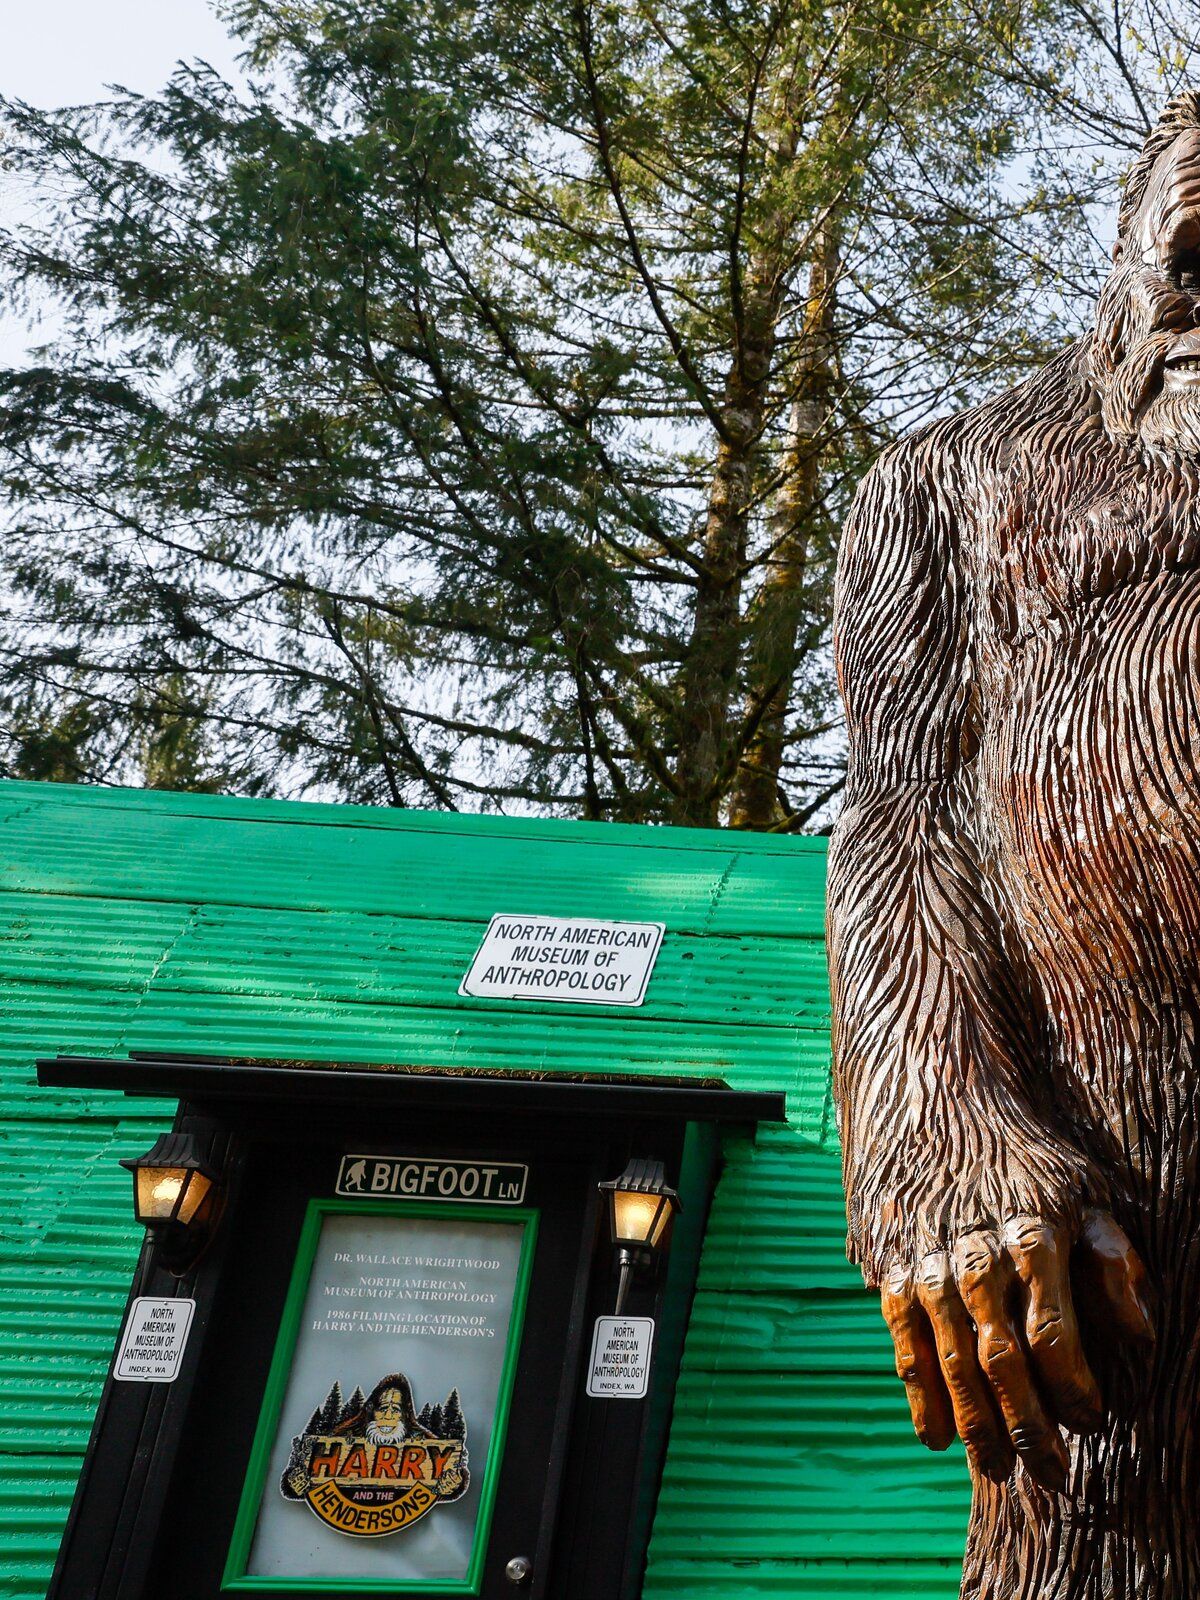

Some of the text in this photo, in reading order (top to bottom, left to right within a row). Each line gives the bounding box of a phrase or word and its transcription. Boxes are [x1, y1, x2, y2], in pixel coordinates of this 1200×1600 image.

[495, 924, 651, 948] NORTH AMERICAN
[511, 946, 618, 967] MUSEUM OF
[481, 966, 632, 991] ANTHROPOLOGY
[371, 1163, 519, 1198] BIGFOOT LN
[334, 1253, 500, 1270] DR. WALLACE WRIGHTWOOD
[359, 1277, 467, 1290] NORTH AMERICAN
[324, 1287, 497, 1303] MUSEUM OF ANTHROPOLOGY
[150, 1308, 174, 1319] NORTH
[327, 1310, 487, 1326] 1986 FILMING LOCATION OF
[141, 1322, 176, 1333] AMERICAN
[312, 1321, 356, 1332] HARRY
[357, 1323, 383, 1333] AND
[385, 1324, 410, 1334] THE
[613, 1327, 635, 1338] NORTH
[135, 1335, 175, 1347] MUSEUM OF
[606, 1340, 639, 1351] AMERICAN
[124, 1349, 178, 1361] ANTHROPOLOGY
[602, 1353, 639, 1364] MUSEUM OF
[594, 1367, 644, 1378] ANTHROPOLOGY
[308, 1442, 456, 1480] HARRY
[352, 1491, 394, 1500] AND THE
[313, 1485, 430, 1530] HENDERSONS
